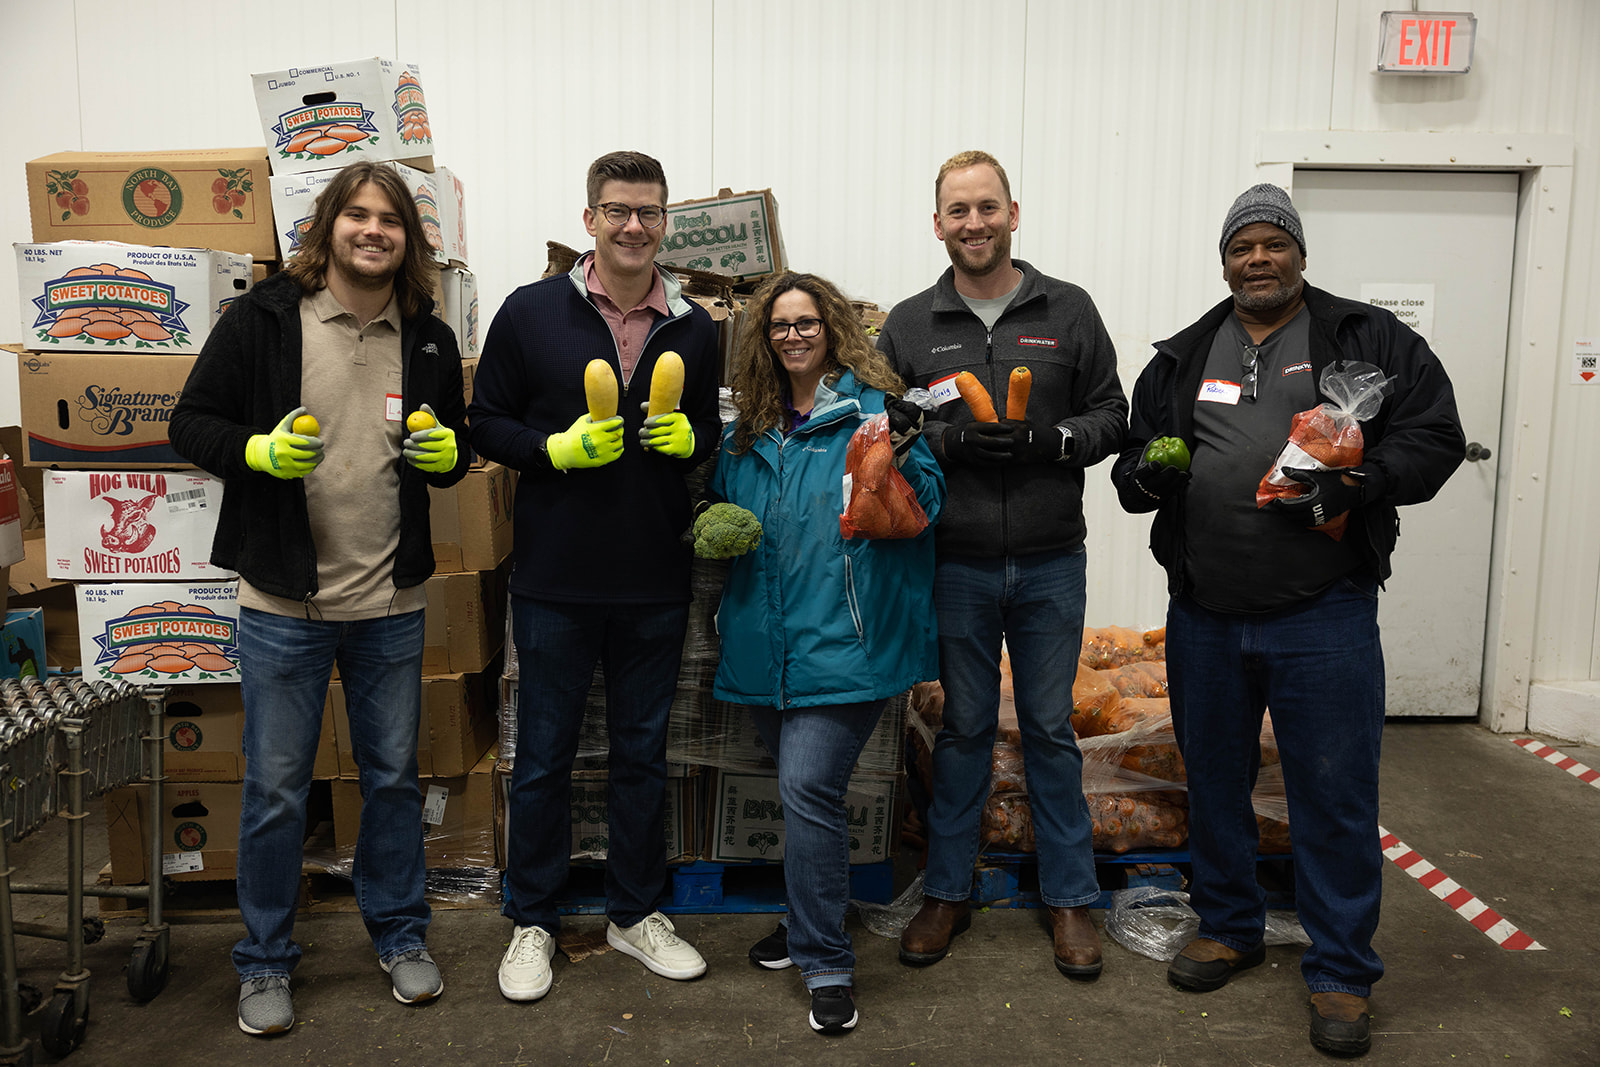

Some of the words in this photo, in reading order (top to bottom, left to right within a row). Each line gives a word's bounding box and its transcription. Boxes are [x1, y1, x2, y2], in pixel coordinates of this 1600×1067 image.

[1399, 20, 1456, 66] EXIT
[298, 67, 334, 76] COMMERCIAL
[287, 111, 314, 127] SWEET
[317, 107, 363, 118] POTATOES
[125, 170, 157, 191] NORTH
[161, 174, 179, 191] BAY
[130, 210, 177, 226] PRODUCE
[674, 211, 711, 231] Fresh
[51, 285, 94, 301] SWEET
[98, 285, 167, 305] POTATOES
[1370, 298, 1398, 306] Please
[1401, 298, 1425, 306] close
[1406, 320, 1420, 328] ou!
[937, 343, 962, 352] Columbia
[1020, 338, 1056, 346] DRINKWATER
[75, 385, 175, 412] Signature
[933, 388, 951, 399] Craig
[89, 474, 121, 500] HOG
[126, 474, 167, 498] WILD
[84, 547, 121, 574] SWEET
[124, 547, 180, 574] POTATOES
[114, 622, 158, 640] SWEET
[162, 621, 229, 637] POTATOES
[177, 789, 199, 797] APPLES
